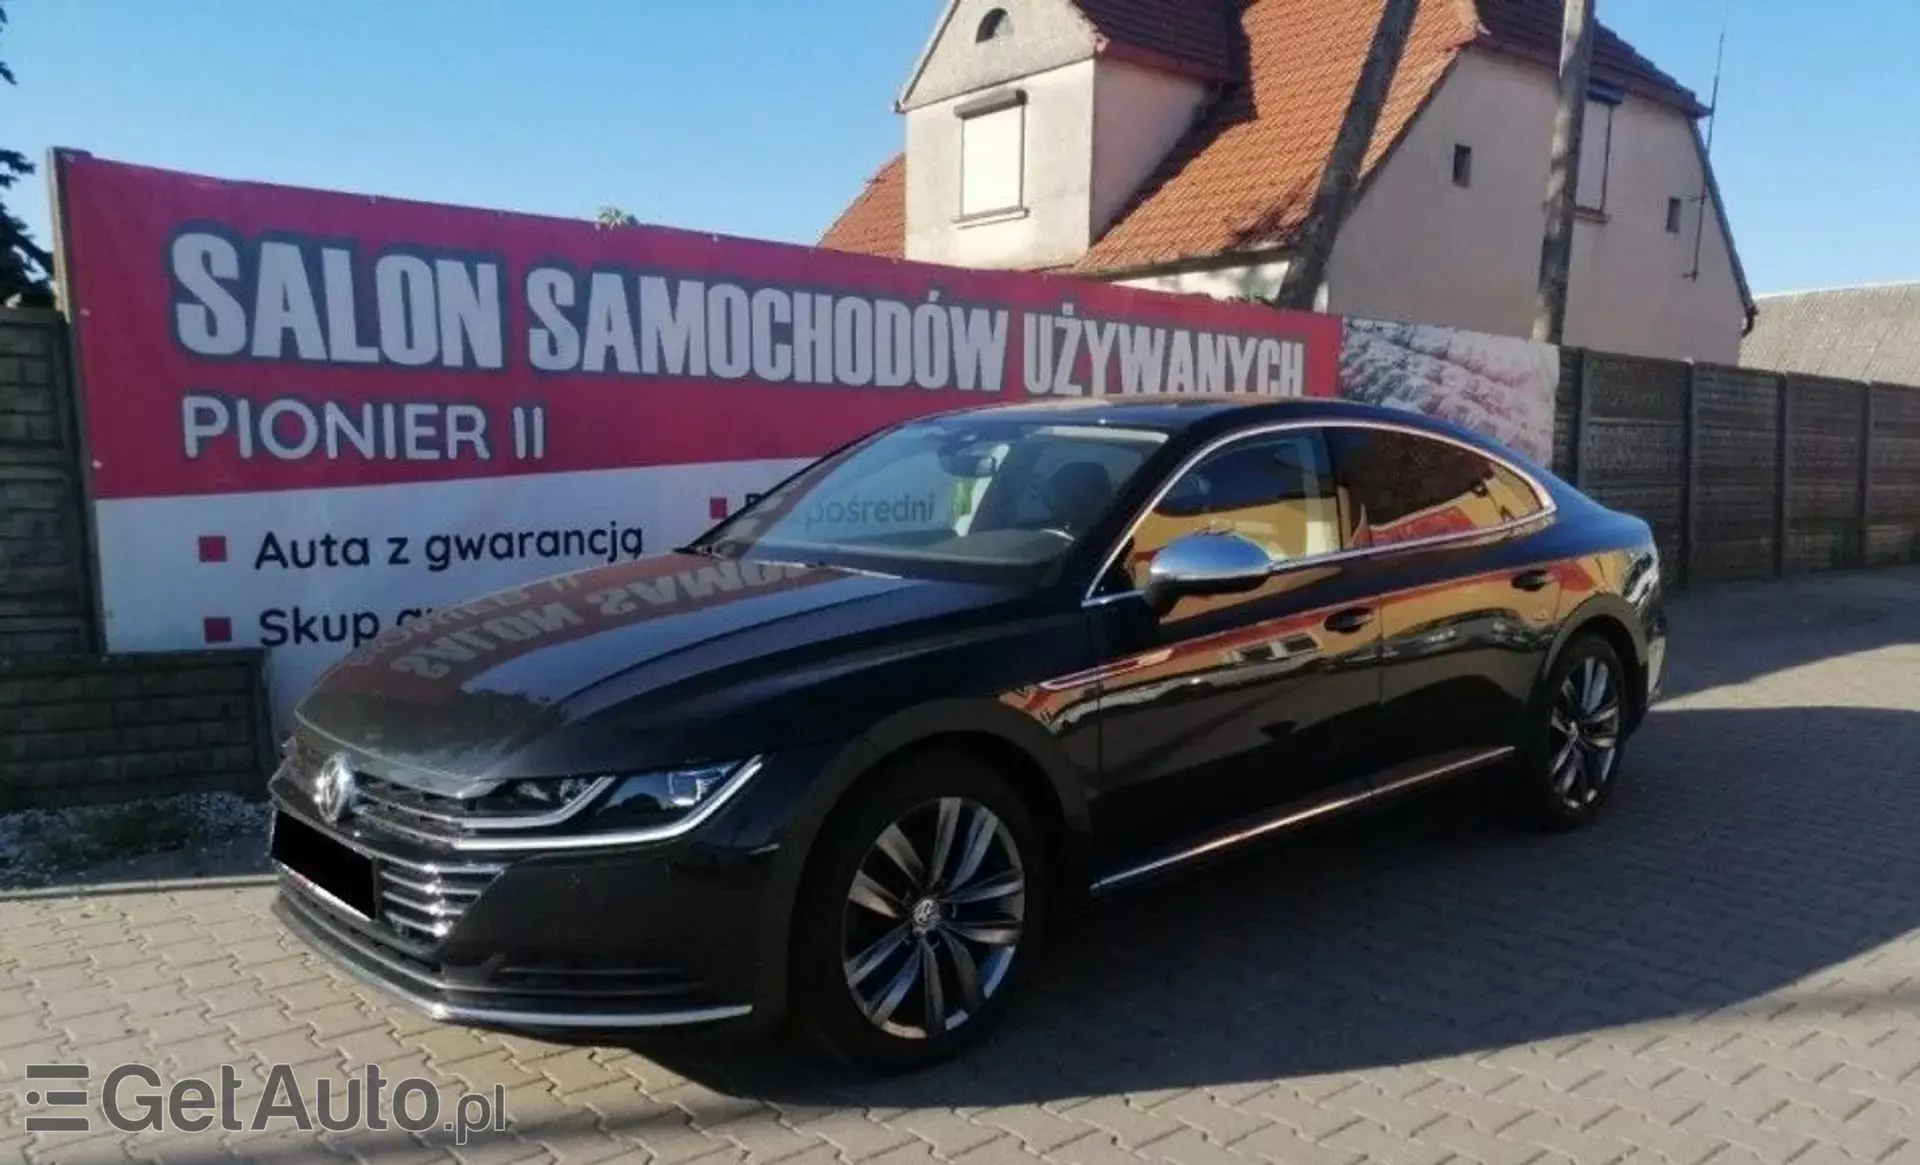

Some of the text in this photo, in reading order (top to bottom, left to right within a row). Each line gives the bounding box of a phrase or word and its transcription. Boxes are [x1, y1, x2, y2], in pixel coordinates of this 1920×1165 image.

[171, 231, 1304, 397] SALON SAMOCHODÓW UŻYWANYCH
[182, 395, 545, 461] PIONIER II
[254, 520, 644, 573] Auta z gwarancją
[259, 606, 381, 649] Skup
